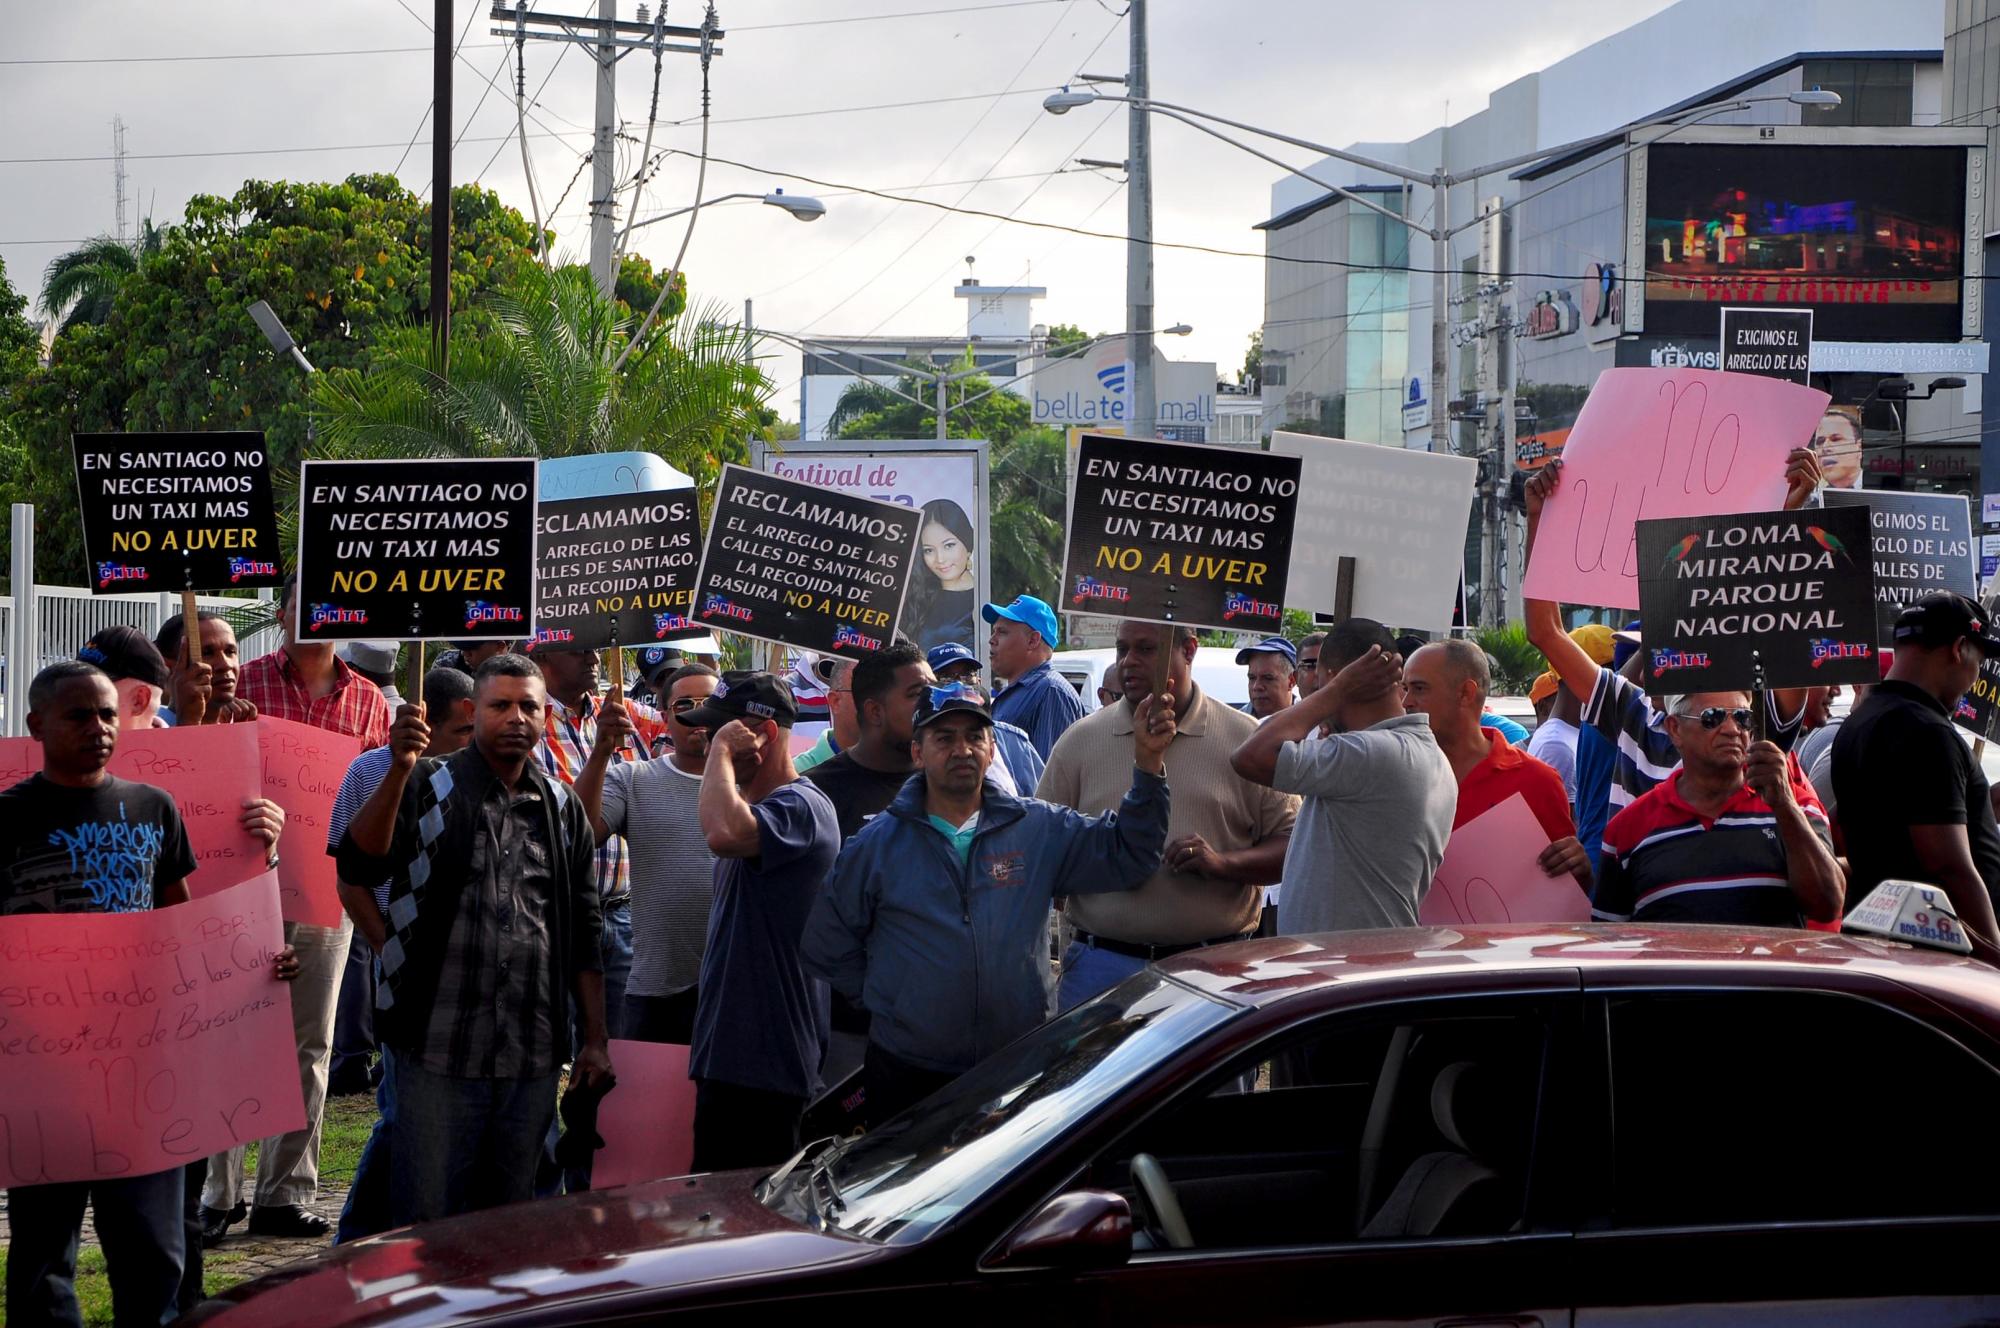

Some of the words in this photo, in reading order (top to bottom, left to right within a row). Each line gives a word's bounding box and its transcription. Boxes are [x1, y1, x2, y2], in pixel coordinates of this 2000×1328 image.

[1737, 330, 1785, 346] EXIGIMOS
[1788, 330, 1799, 346] EL
[1726, 353, 1772, 371] ARREGLO
[1774, 354, 1792, 370] DE
[1792, 354, 1807, 370] LAS
[1161, 395, 1213, 422] mall
[84, 453, 113, 470] EN
[119, 451, 226, 469] SANTIAGO
[234, 450, 263, 468] NO
[103, 476, 252, 495] NECESITAMOS
[868, 464, 898, 487] de
[1086, 458, 1121, 478] EN
[1126, 463, 1252, 493] SANTIAGO
[1259, 477, 1297, 497] NO
[312, 486, 347, 504] EN
[355, 484, 482, 503] SANTIAGO
[490, 482, 528, 501] NO
[113, 503, 143, 520] UN
[149, 502, 197, 519] TAXI
[204, 501, 249, 518] MAS
[730, 485, 908, 545] RECLAMAMOS:
[1101, 489, 1276, 522] NECESITAMOS
[330, 511, 508, 531] NECESITAMOS
[1931, 516, 1950, 531] EL
[112, 531, 152, 551] NO
[161, 530, 178, 550] A
[187, 528, 257, 549] UVER
[727, 516, 747, 532] EL
[752, 522, 834, 554] ARREGLO
[838, 543, 863, 560] DE
[868, 550, 898, 568] LAS
[1105, 516, 1140, 537] UN
[1150, 521, 1203, 543] TAXI
[1211, 528, 1265, 550] MAS
[1706, 524, 1801, 548] LOMA
[337, 540, 374, 558] UN
[382, 540, 438, 558] TAXI
[446, 538, 500, 557] MAS
[546, 538, 626, 560] ARREGLO
[632, 537, 653, 551] DE
[663, 533, 691, 548] LAS
[1872, 537, 1908, 554] GLO
[1913, 539, 1934, 555] DE
[1939, 541, 1967, 557] LAS
[100, 567, 146, 579] CNTT
[231, 562, 274, 574] CNTT
[585, 560, 607, 575] DE
[612, 552, 698, 573] SANTIAGO,
[721, 536, 794, 563] CALLES
[797, 551, 822, 568] DE
[825, 557, 898, 591] SANTIAGO,
[1096, 545, 1142, 571] NO
[1151, 553, 1171, 575] A
[1181, 555, 1268, 585] UVER
[1677, 552, 1835, 579] MIRANDA
[1924, 564, 1945, 580] DE
[331, 570, 378, 593] NO
[387, 570, 408, 592] A
[419, 569, 506, 592] UVER
[541, 585, 562, 599] LA
[567, 577, 649, 597] RECOJIDA
[654, 574, 677, 588] DE
[736, 559, 758, 575] LA
[762, 564, 844, 597] RECOJIDA
[848, 586, 873, 603] DE
[1077, 583, 1128, 600] CNTT
[595, 597, 624, 613] NO
[631, 595, 645, 610] A
[709, 574, 778, 602] BASURA
[783, 590, 813, 609] NO
[816, 599, 832, 615] A
[836, 602, 890, 628] UVER
[1690, 581, 1824, 607] PARQUE
[314, 609, 366, 623] CNTT
[468, 607, 520, 620] CNTT
[706, 599, 753, 620] CNTT
[1228, 599, 1279, 617] CNTT
[1674, 610, 1844, 638] NACIONAL
[838, 631, 881, 651] CNTT
[1814, 644, 1868, 658] CNTT
[1655, 653, 1708, 668] CNTT
[1922, 890, 1935, 902] U
